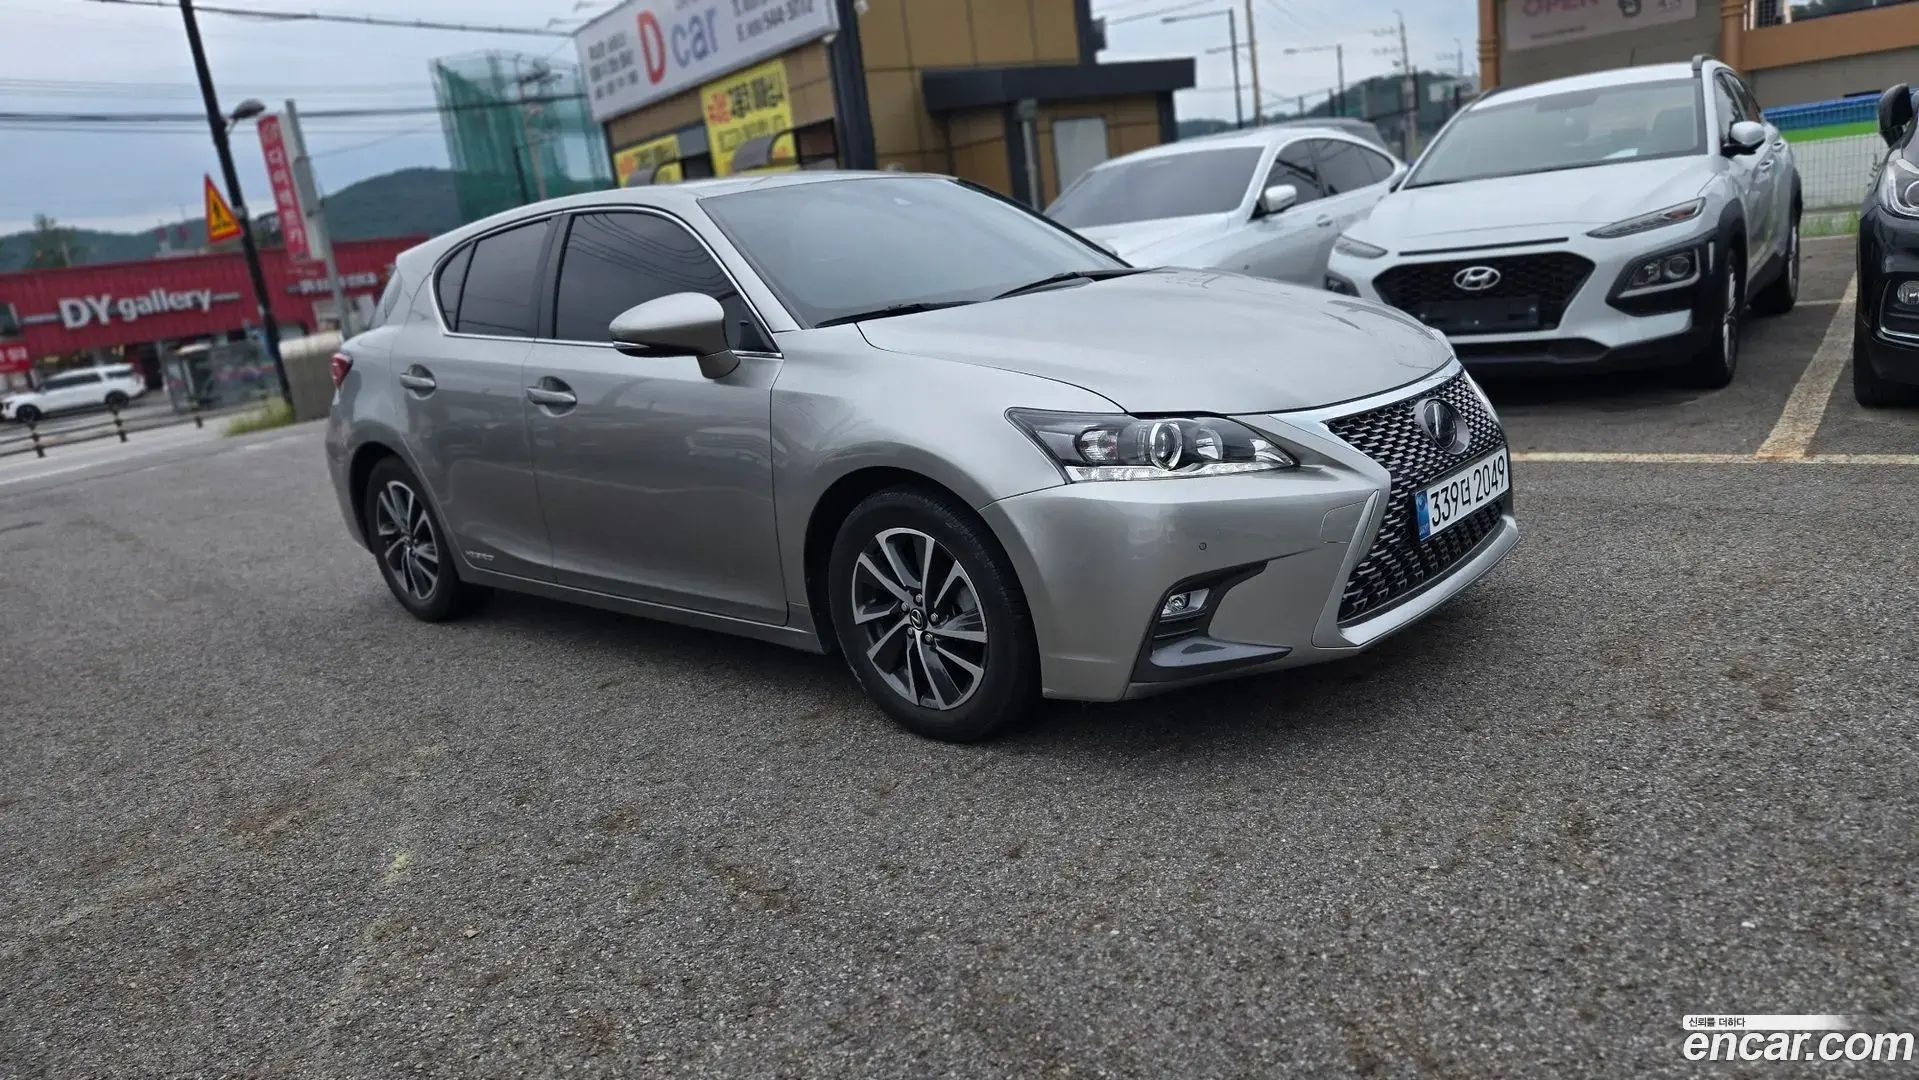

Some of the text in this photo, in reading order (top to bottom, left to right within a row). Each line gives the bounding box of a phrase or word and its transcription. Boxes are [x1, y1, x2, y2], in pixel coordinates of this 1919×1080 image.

[1522, 0, 1599, 17] OPE
[637, 9, 666, 85] D
[670, 7, 719, 69] car
[58, 287, 212, 329] DY gallery
[1430, 455, 1505, 527] 339더 2049
